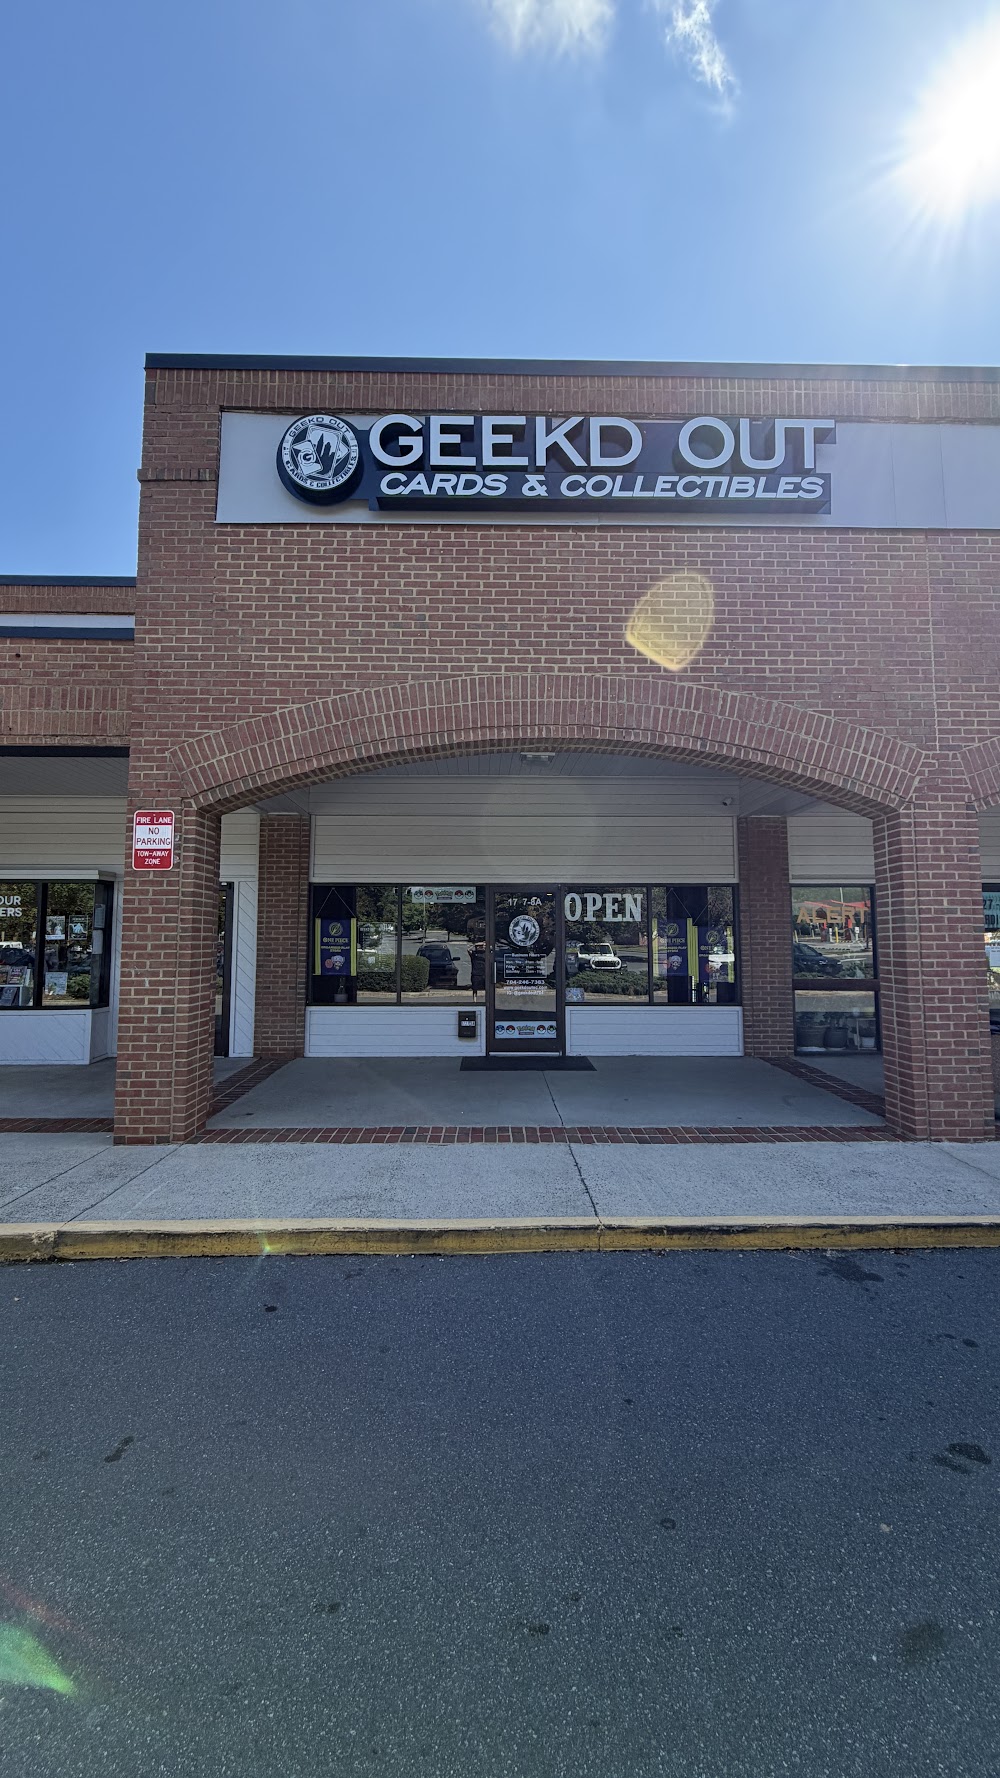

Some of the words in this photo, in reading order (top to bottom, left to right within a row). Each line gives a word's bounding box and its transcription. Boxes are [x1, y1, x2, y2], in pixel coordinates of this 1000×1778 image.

[329, 419, 350, 434] OUT
[369, 415, 643, 468] GEEKD
[678, 416, 836, 470] OUT
[380, 473, 508, 496] CARDS
[521, 474, 549, 496] &
[559, 475, 826, 499] COLLECTIBLES
[136, 816, 151, 824] FIRE
[153, 816, 172, 824] LANE
[148, 827, 160, 835] NO
[136, 837, 171, 846] PARKING
[564, 893, 644, 922] OPEN
[796, 907, 869, 924] ALERT
